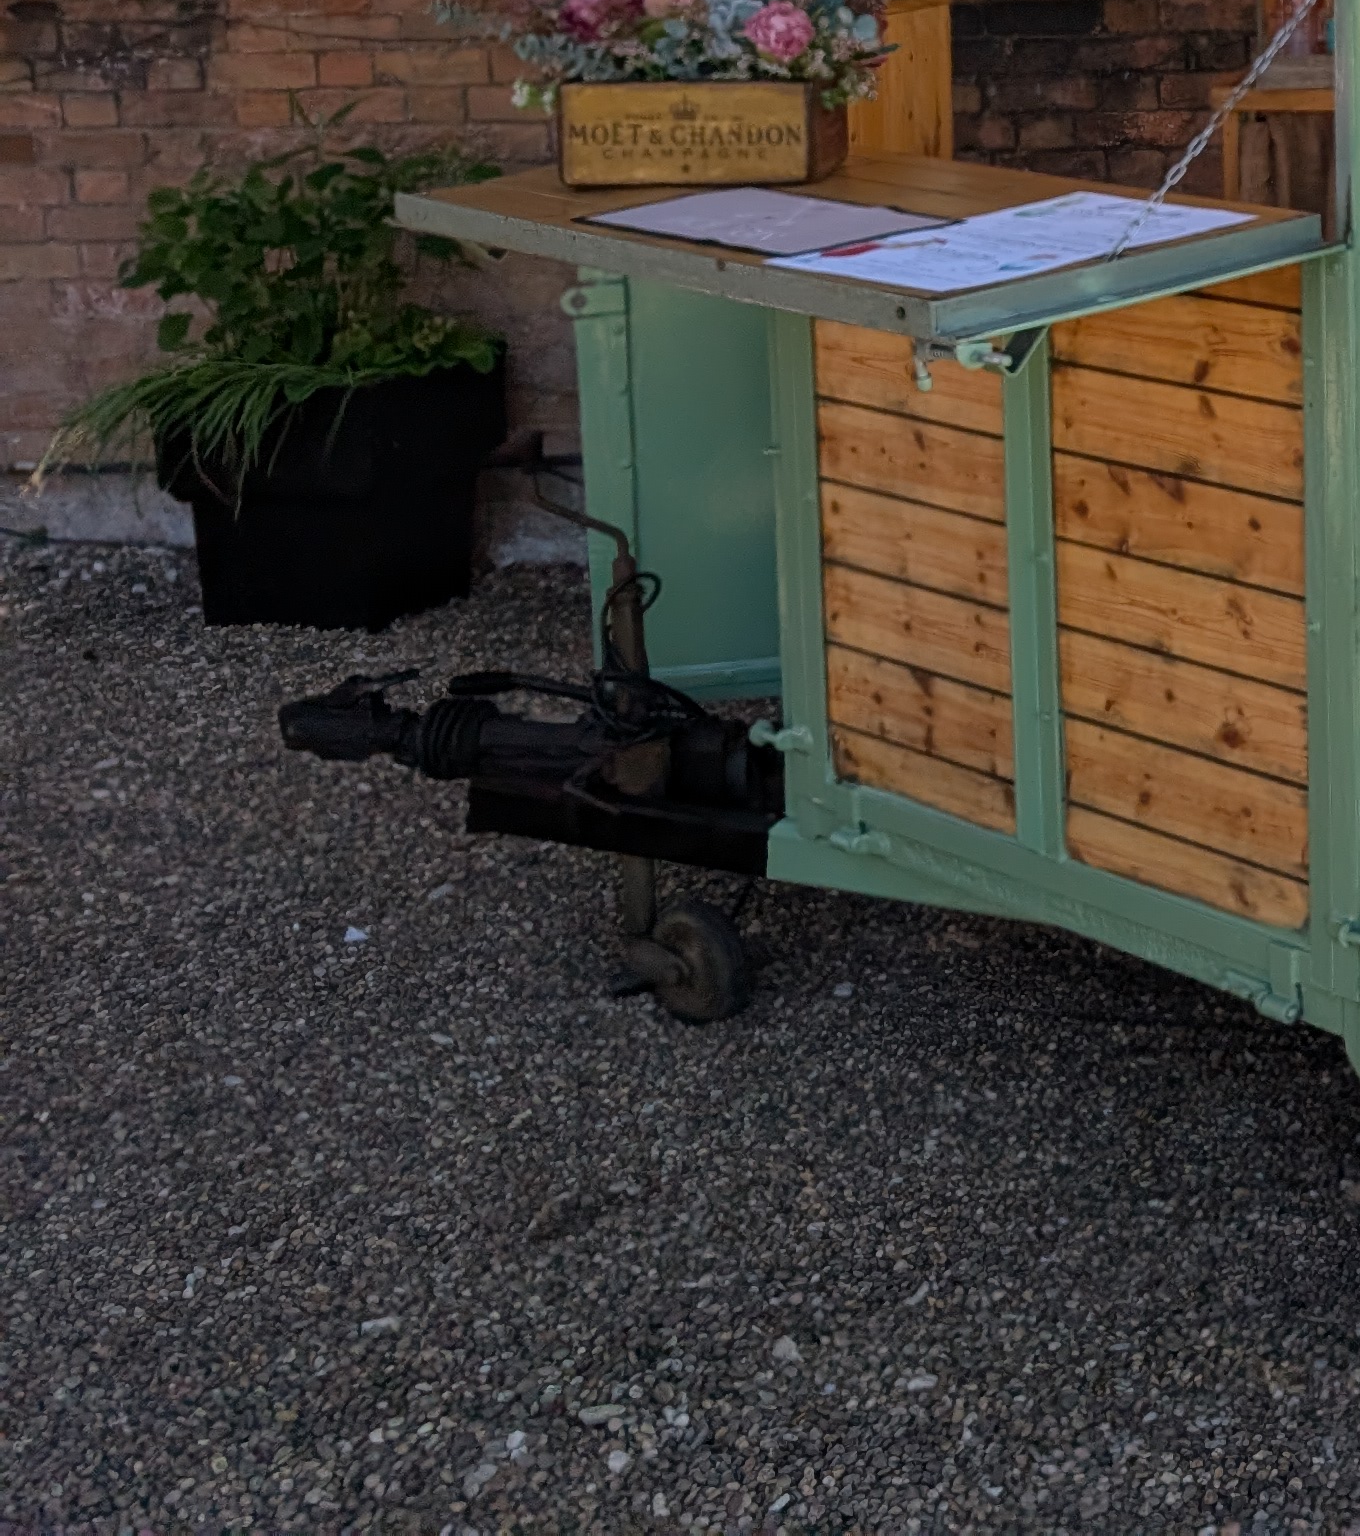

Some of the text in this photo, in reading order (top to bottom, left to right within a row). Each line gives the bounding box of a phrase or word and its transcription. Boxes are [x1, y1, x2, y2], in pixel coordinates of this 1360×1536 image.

[649, 128, 662, 146] &
[669, 123, 801, 147] CHANDON
[602, 147, 767, 160] CHAMPAGNE
